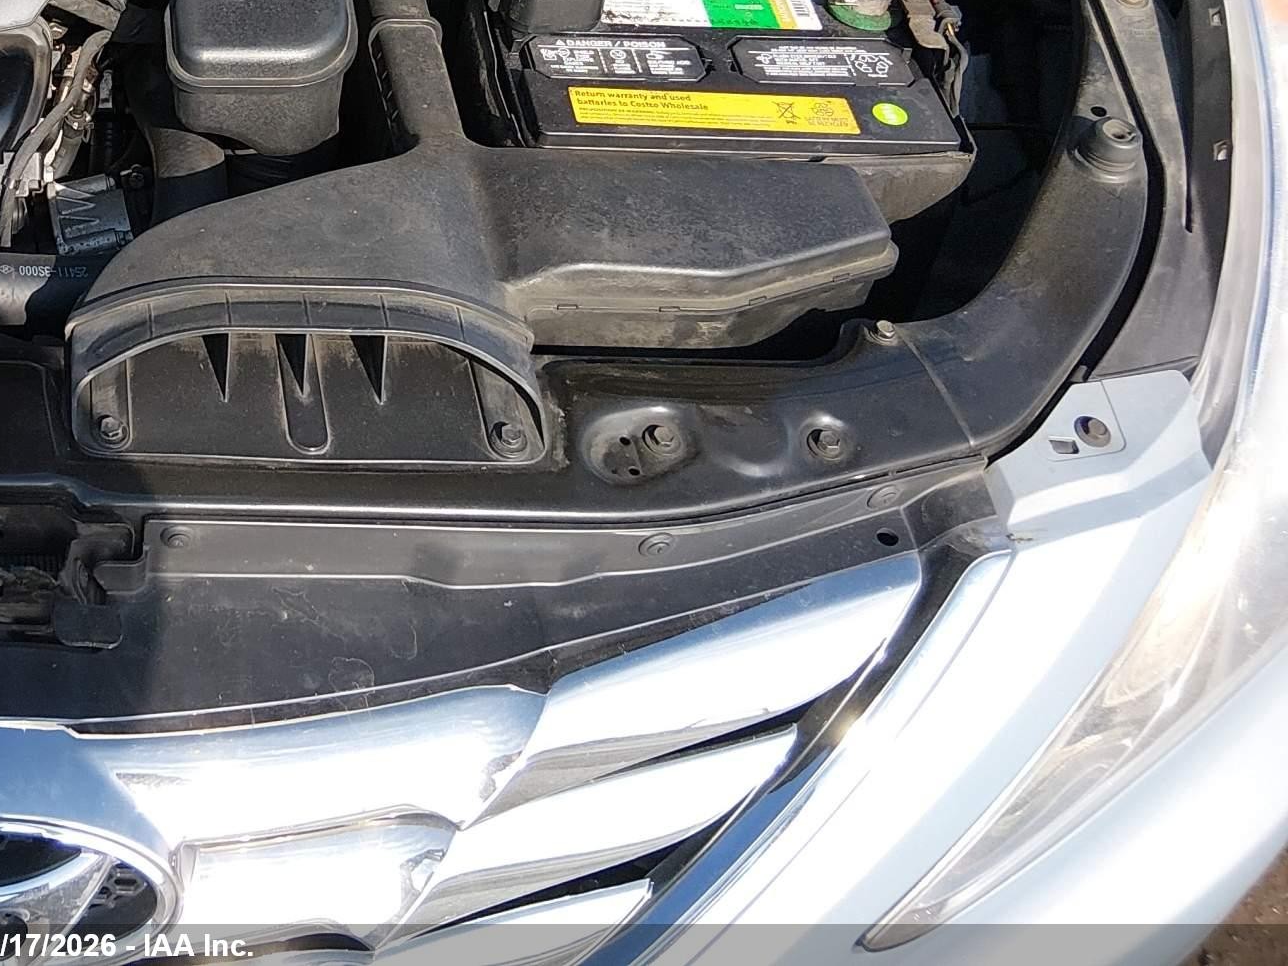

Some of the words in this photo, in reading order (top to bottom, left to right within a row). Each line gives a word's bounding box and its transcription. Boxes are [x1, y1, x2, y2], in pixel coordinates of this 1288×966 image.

[574, 90, 605, 98] Return
[608, 92, 648, 101] warranty
[577, 99, 617, 107] batteries
[661, 102, 709, 110] Wholesale
